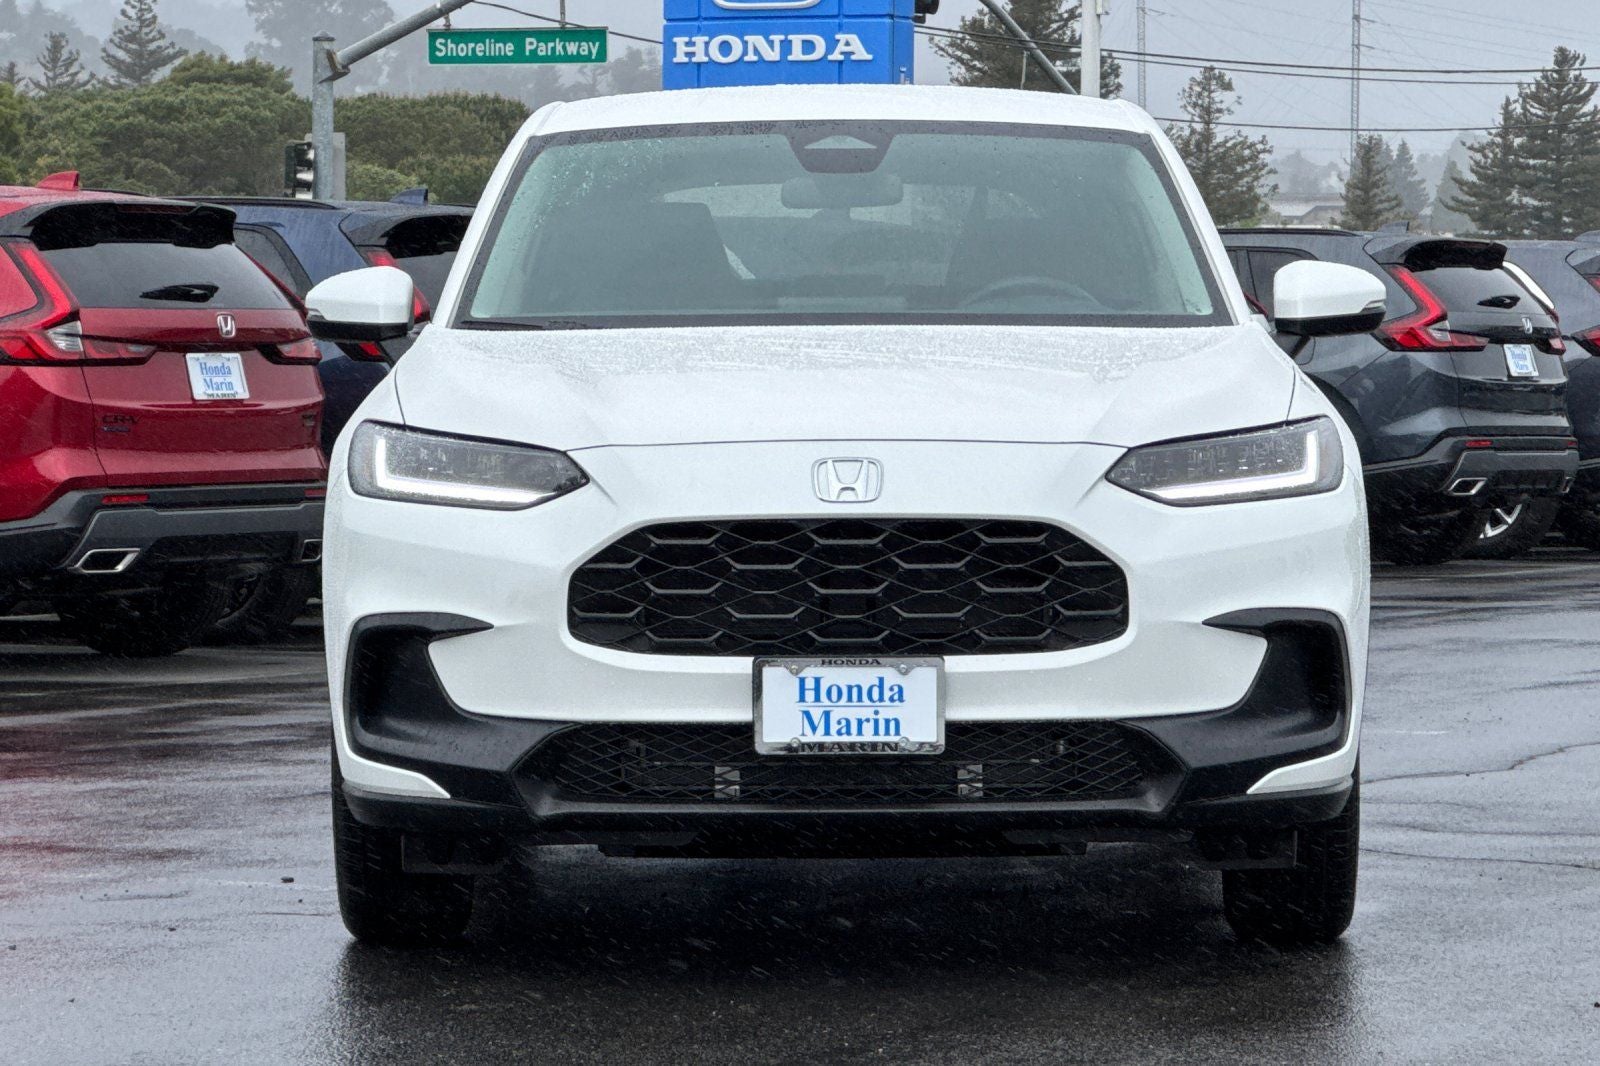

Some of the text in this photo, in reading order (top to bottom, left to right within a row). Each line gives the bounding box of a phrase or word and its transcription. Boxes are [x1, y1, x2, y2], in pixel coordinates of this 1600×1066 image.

[435, 37, 599, 59] Shoreline Parkway
[672, 34, 874, 63] HONDA
[200, 362, 232, 375] Honda
[203, 378, 235, 391] Marin
[821, 658, 882, 666] HONDA
[796, 676, 906, 704] Honda
[799, 708, 902, 737] Marin
[800, 742, 900, 753] MARIN
